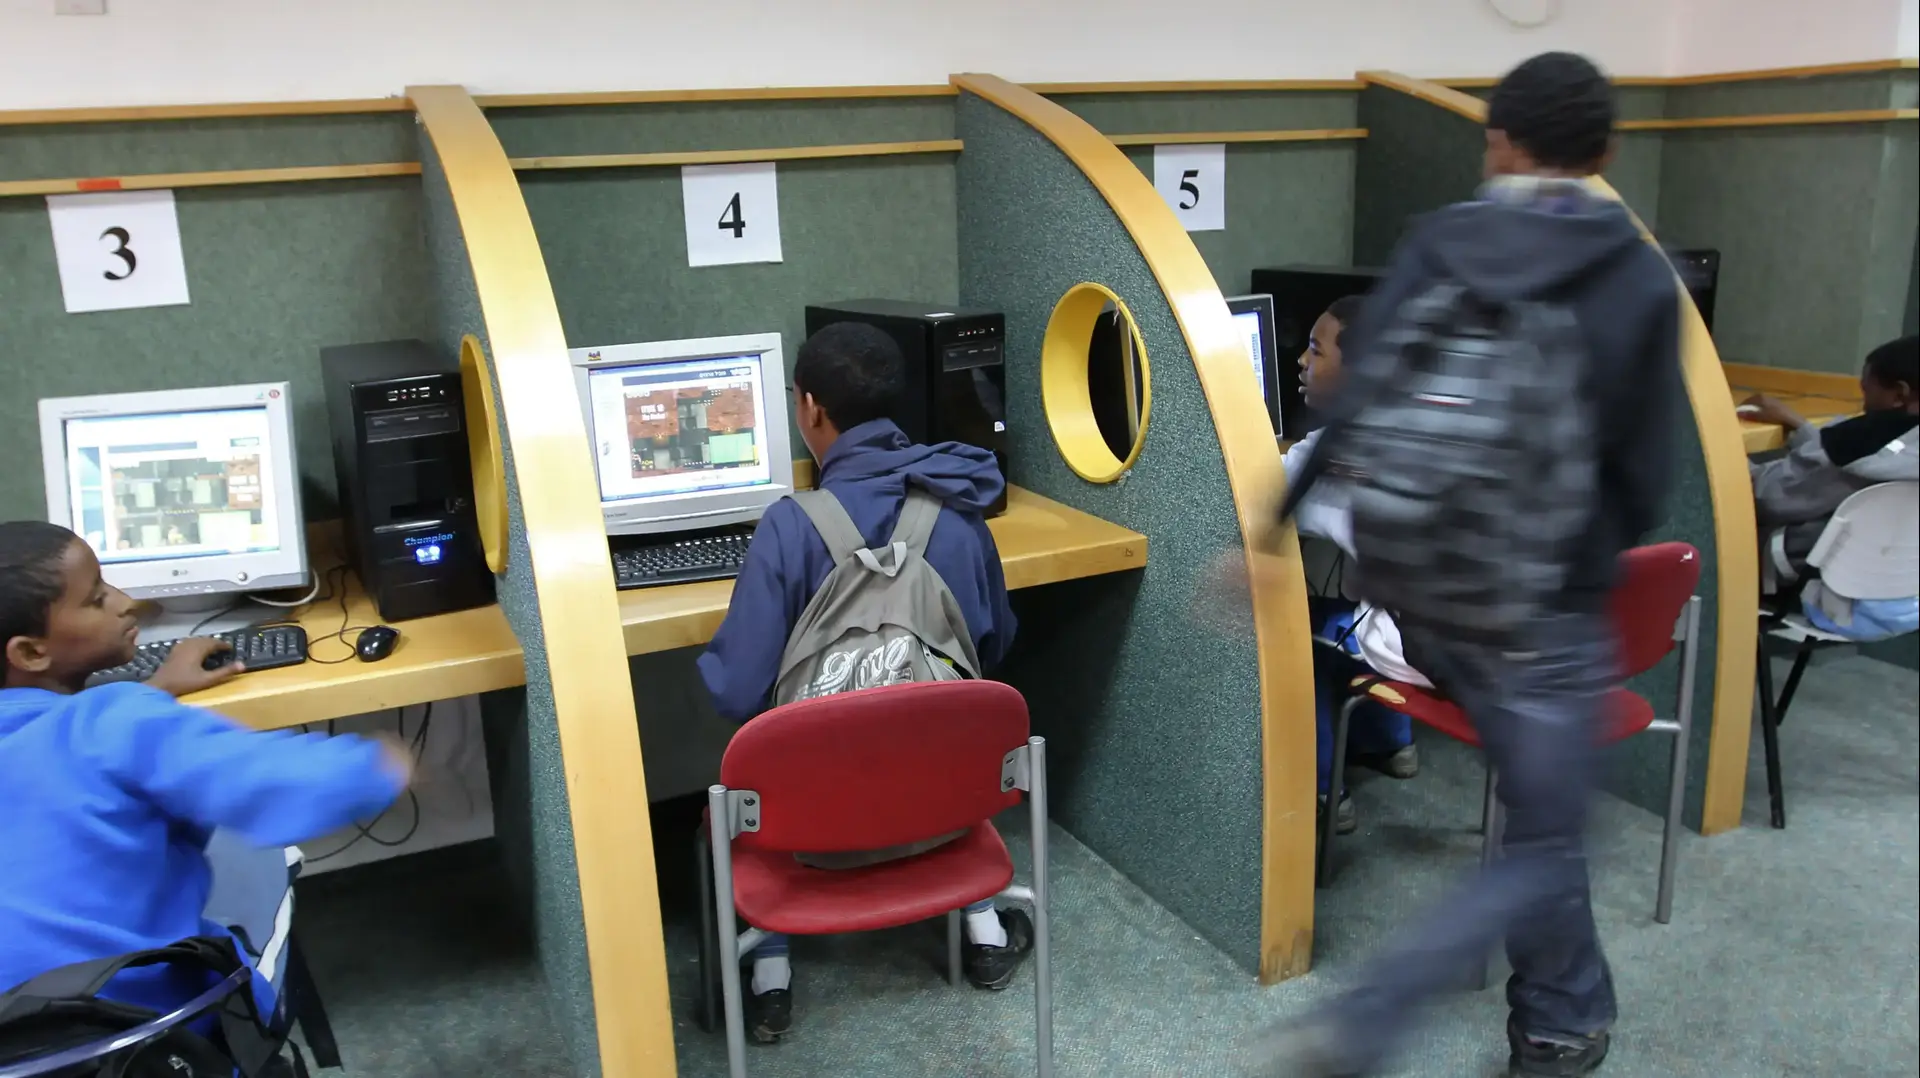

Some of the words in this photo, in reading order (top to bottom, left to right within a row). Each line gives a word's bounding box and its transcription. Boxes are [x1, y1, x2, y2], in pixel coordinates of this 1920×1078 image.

[1179, 169, 1200, 210] 5
[718, 191, 746, 238] 4
[99, 225, 137, 281] 3
[404, 532, 454, 547] Champion
